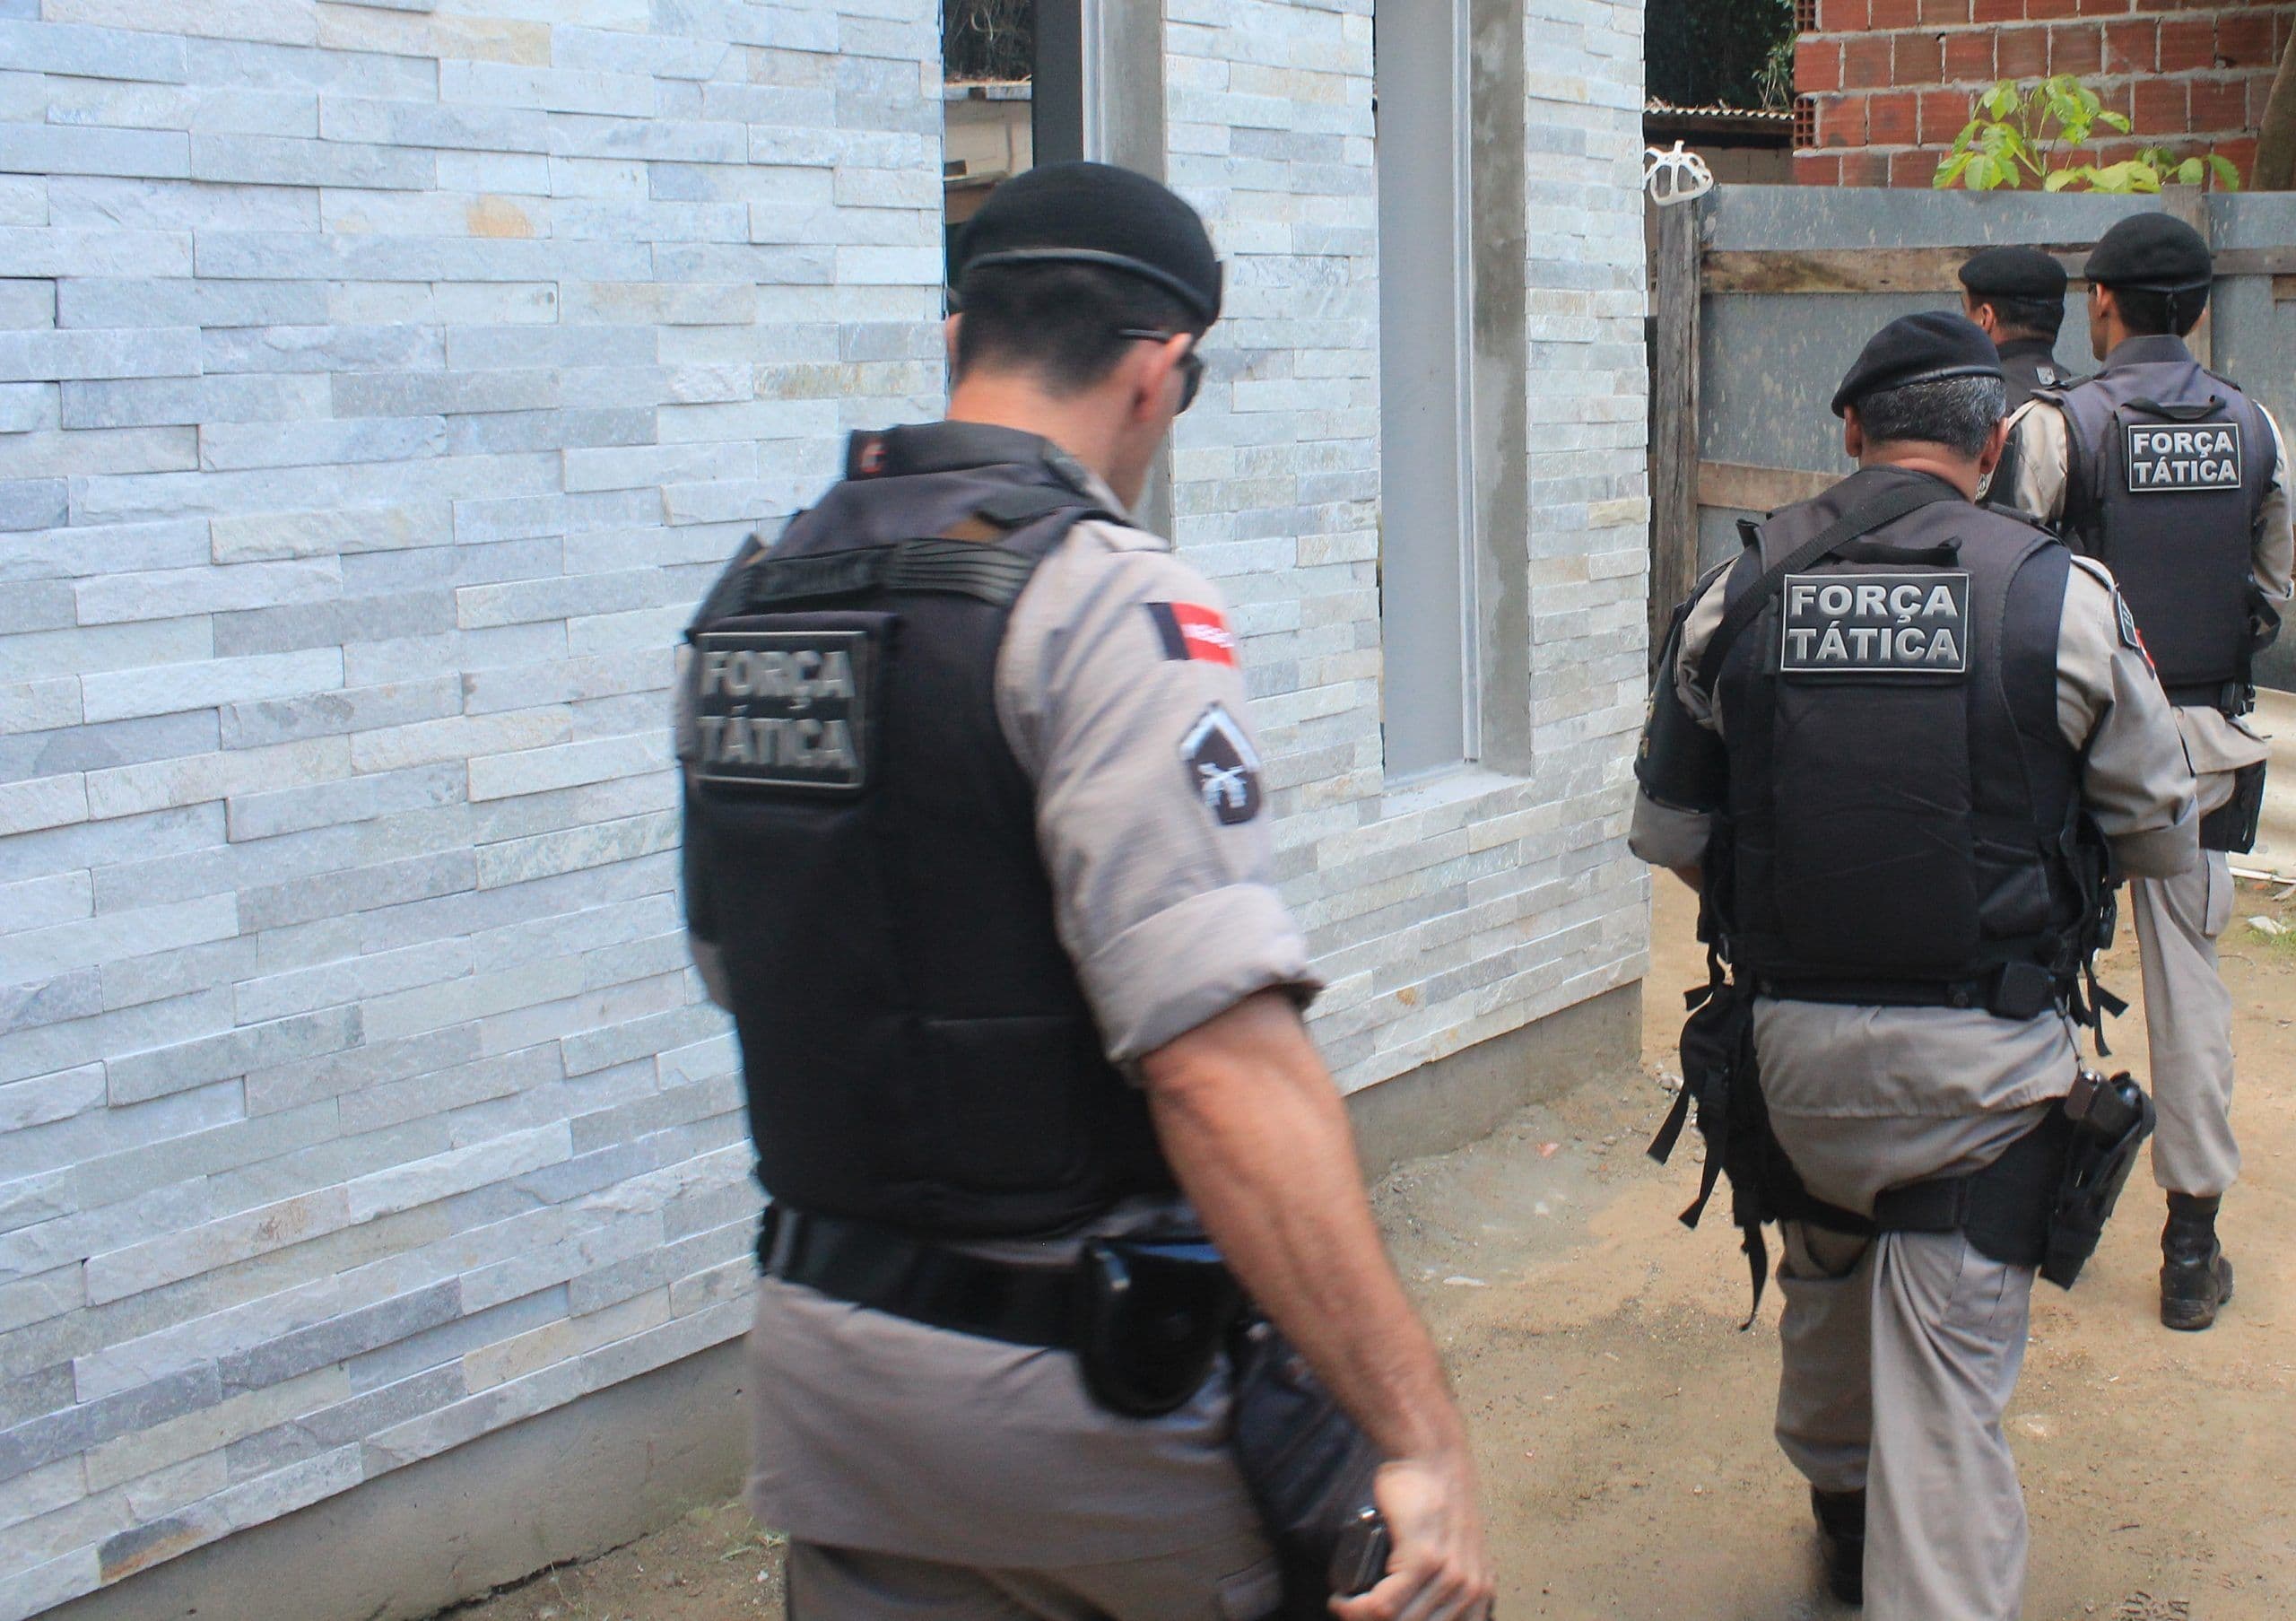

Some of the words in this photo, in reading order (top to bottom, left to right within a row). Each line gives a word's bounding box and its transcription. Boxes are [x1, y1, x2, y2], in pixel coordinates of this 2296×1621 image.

[2134, 431, 2234, 458] FORÇA
[2133, 457, 2238, 484] TÁTICA
[1790, 585, 1959, 623] FORÇA
[1787, 621, 1960, 661] TÁTICA
[701, 650, 856, 709] FORÇA
[696, 704, 858, 768] TÁTICA
